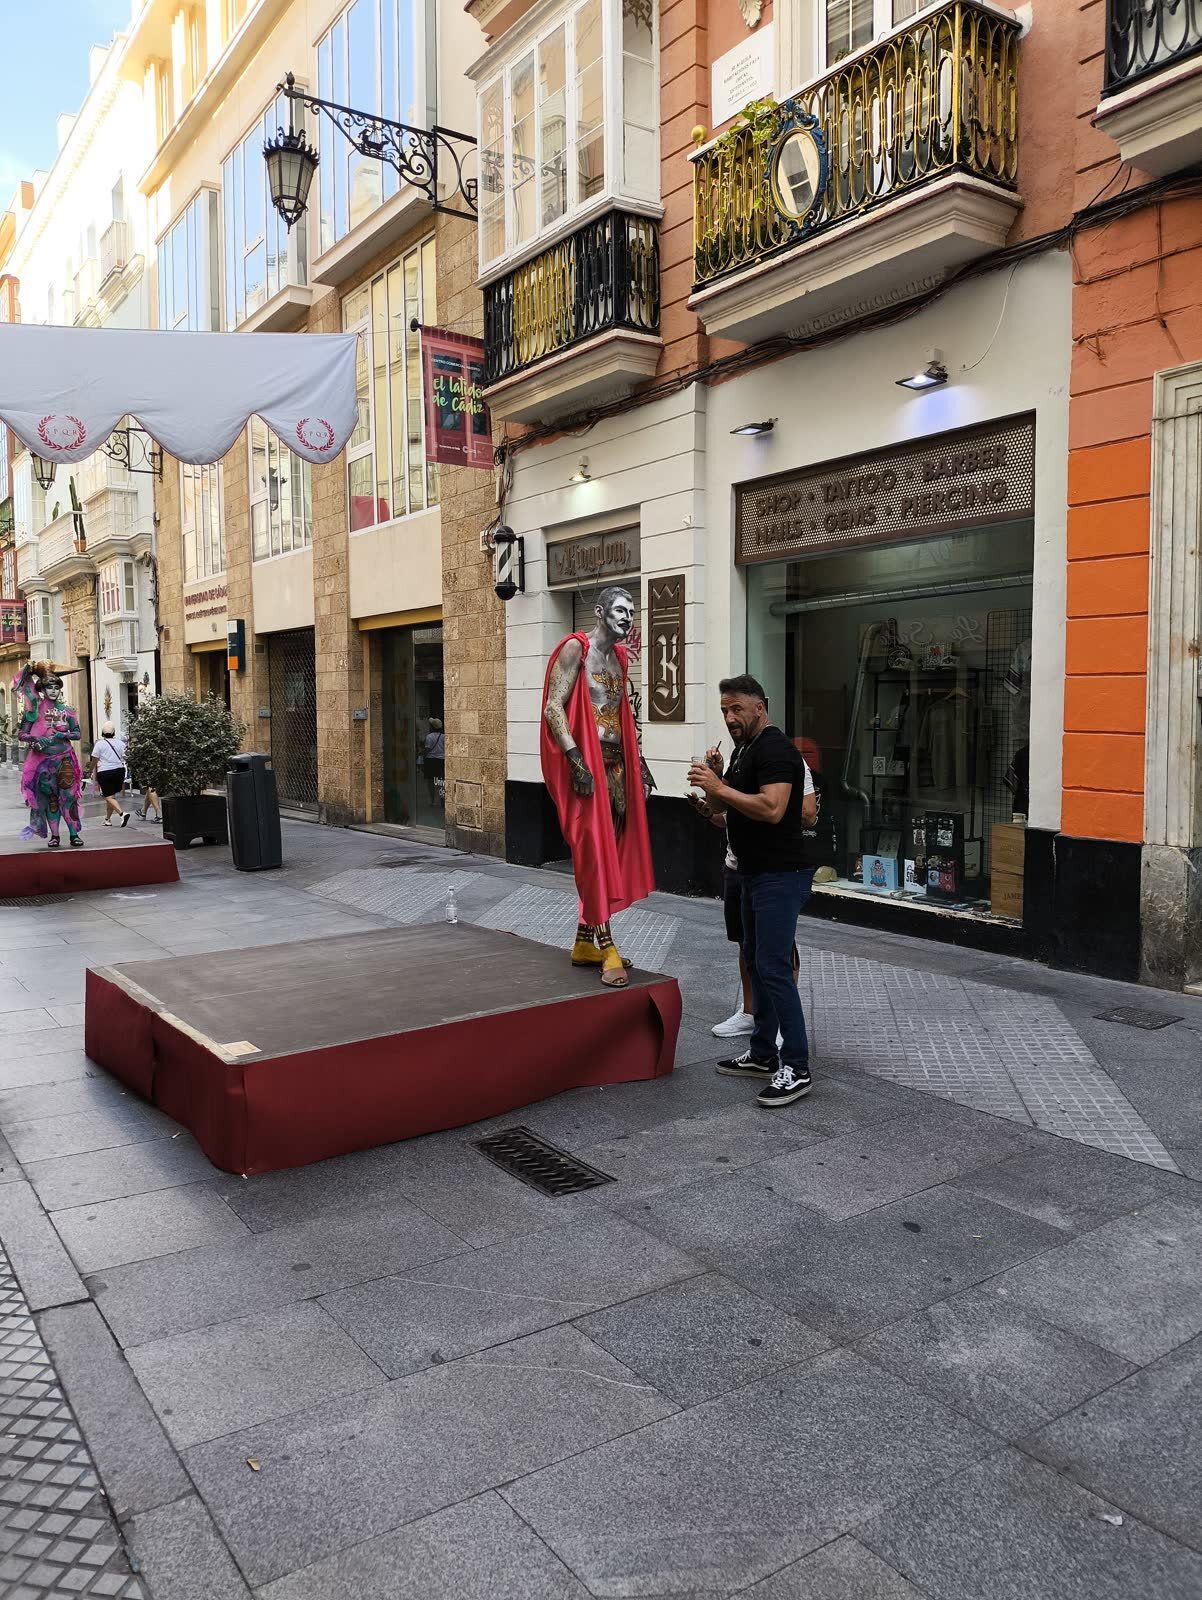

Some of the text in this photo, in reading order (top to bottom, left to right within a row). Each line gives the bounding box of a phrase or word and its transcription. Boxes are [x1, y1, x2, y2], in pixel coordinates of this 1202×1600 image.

[432, 375, 446, 391] El
[432, 391, 485, 416] de Cádiz
[756, 443, 1007, 518] SHOP TATTOO BARBER
[755, 481, 1007, 547] NAILS GEMS PIERCING
